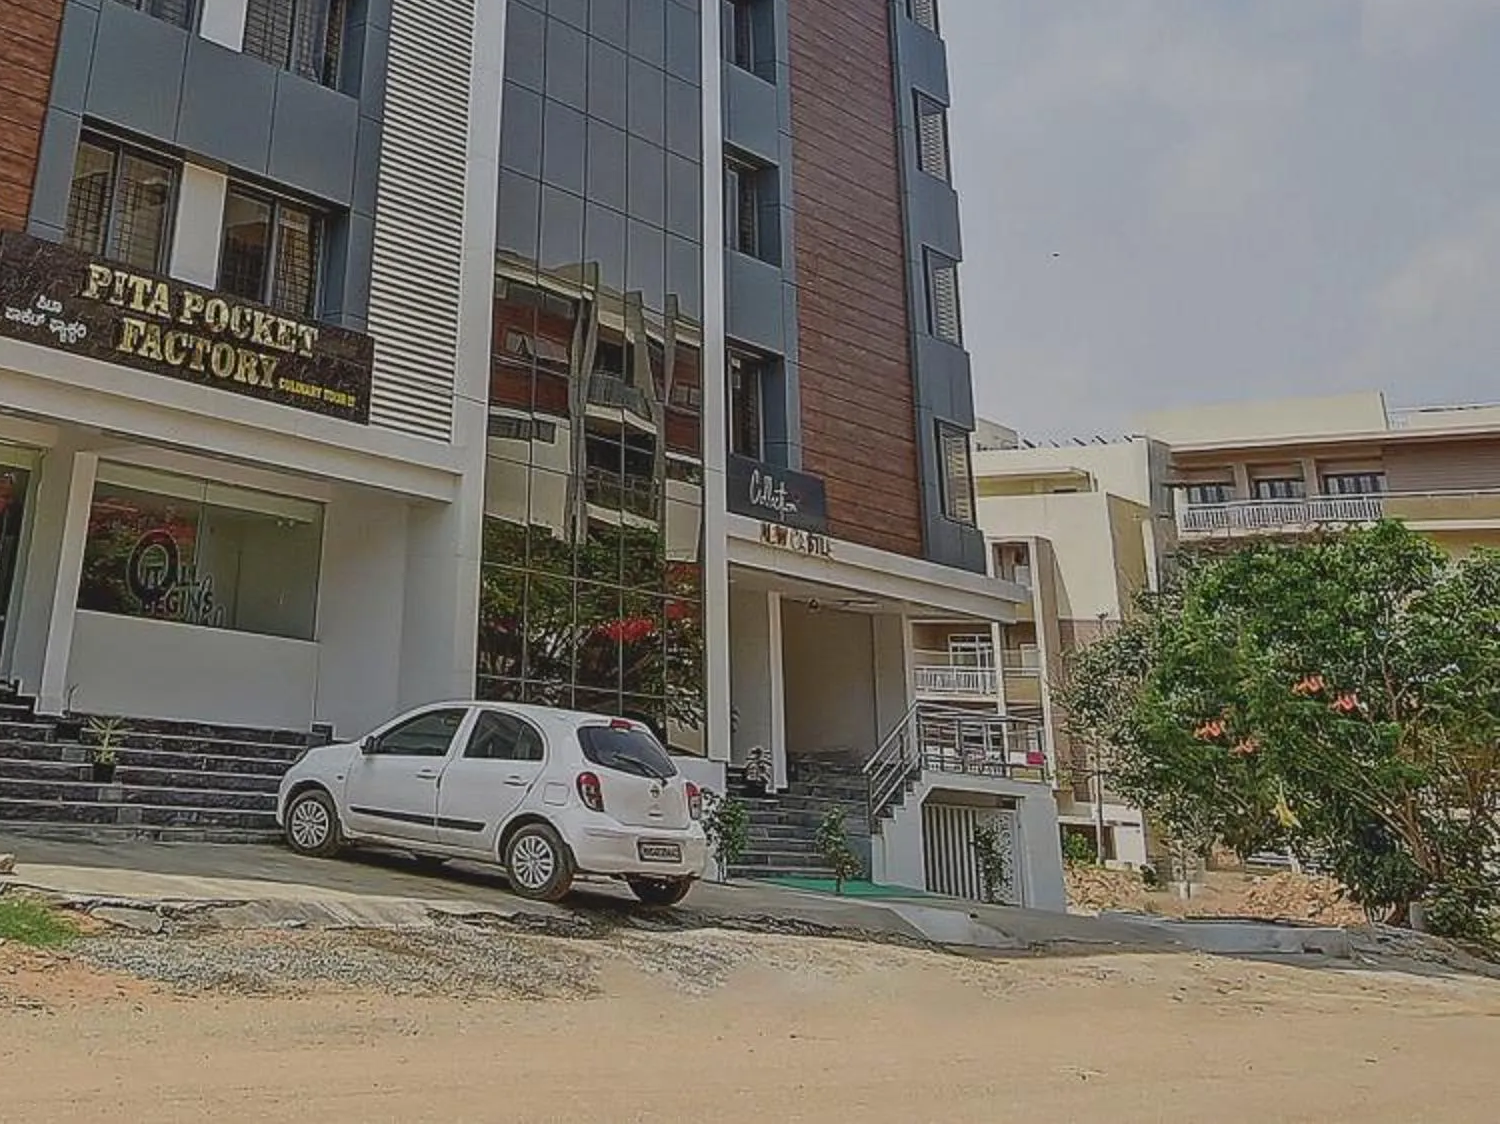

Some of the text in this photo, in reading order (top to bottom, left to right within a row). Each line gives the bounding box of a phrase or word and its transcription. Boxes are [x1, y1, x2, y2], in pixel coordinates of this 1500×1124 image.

[82, 263, 319, 357] PITA POCKET
[117, 317, 279, 389] FACTORY
